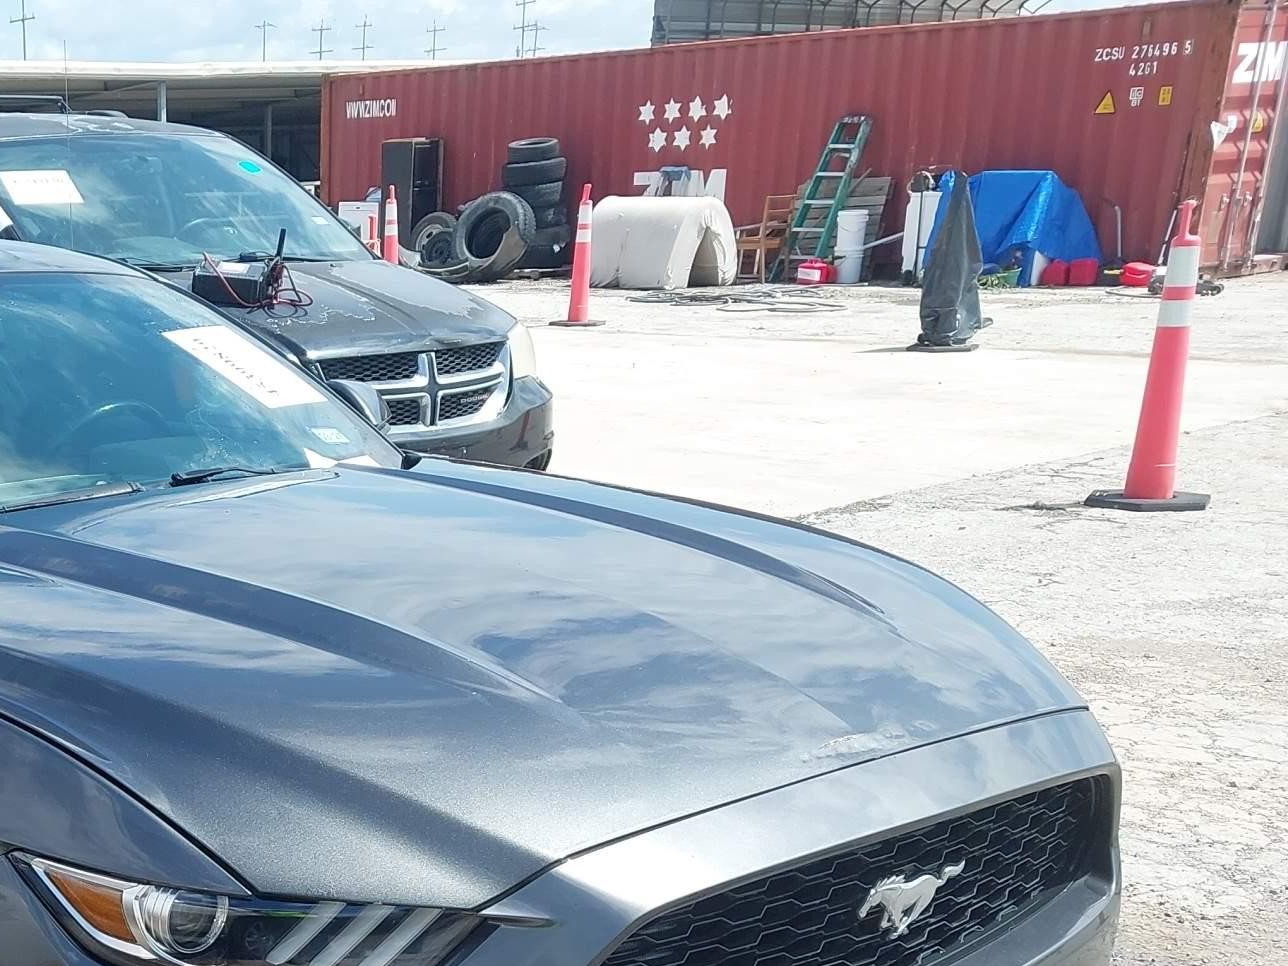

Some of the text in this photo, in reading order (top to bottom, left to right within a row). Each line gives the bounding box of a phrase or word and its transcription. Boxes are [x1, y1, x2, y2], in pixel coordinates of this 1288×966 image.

[1095, 39, 1194, 62] ZCSU 276496 5
[1232, 41, 1288, 84] ZIM
